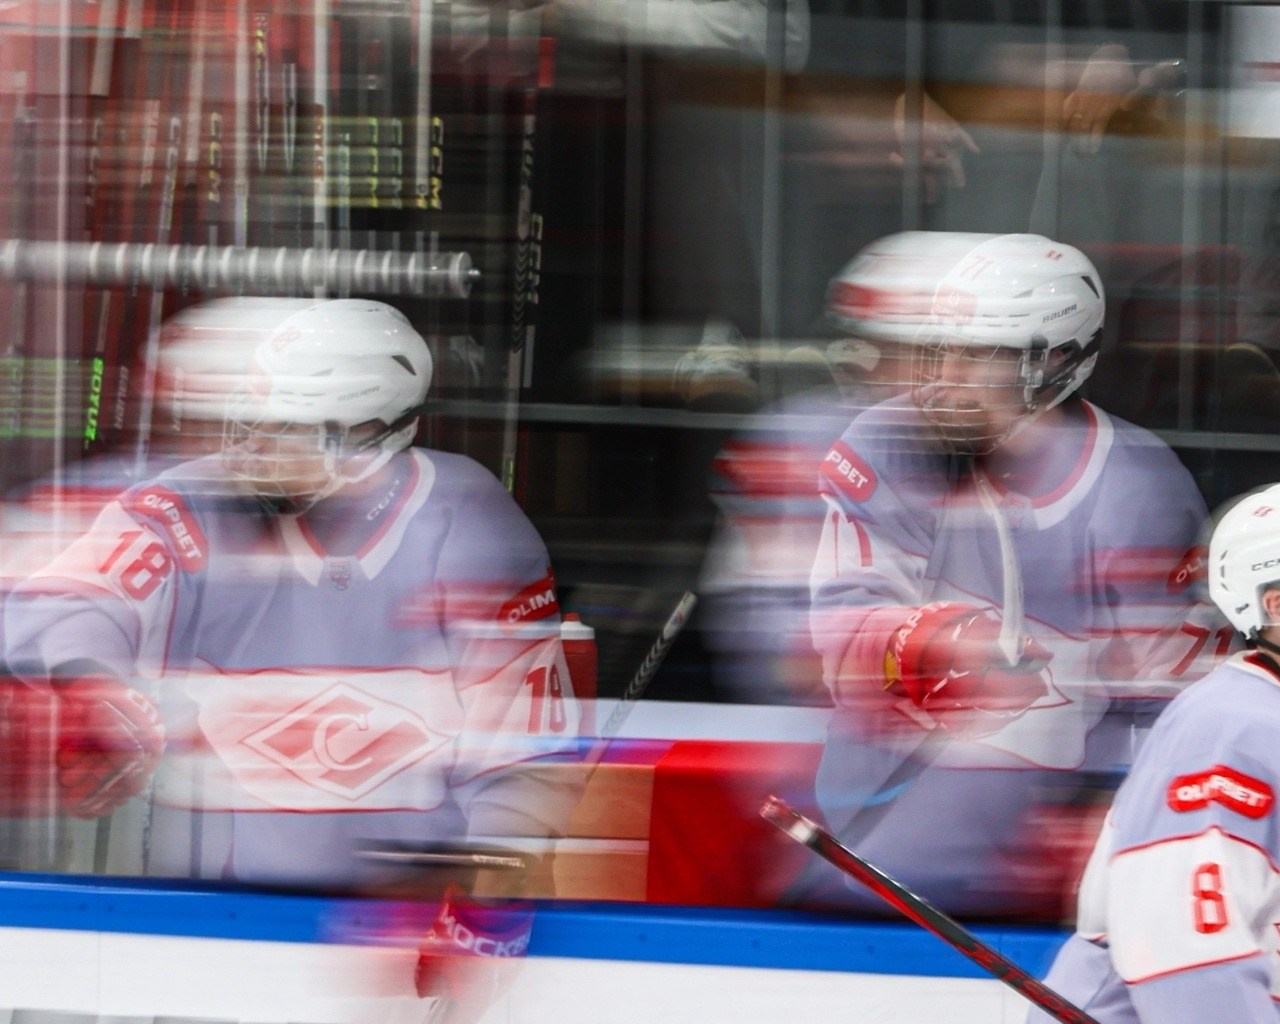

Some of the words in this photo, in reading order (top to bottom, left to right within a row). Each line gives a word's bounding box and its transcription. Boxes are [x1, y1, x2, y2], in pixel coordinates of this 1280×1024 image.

[98, 530, 173, 602] 18
[1169, 620, 1236, 679] 71
[1193, 861, 1230, 934] 8
